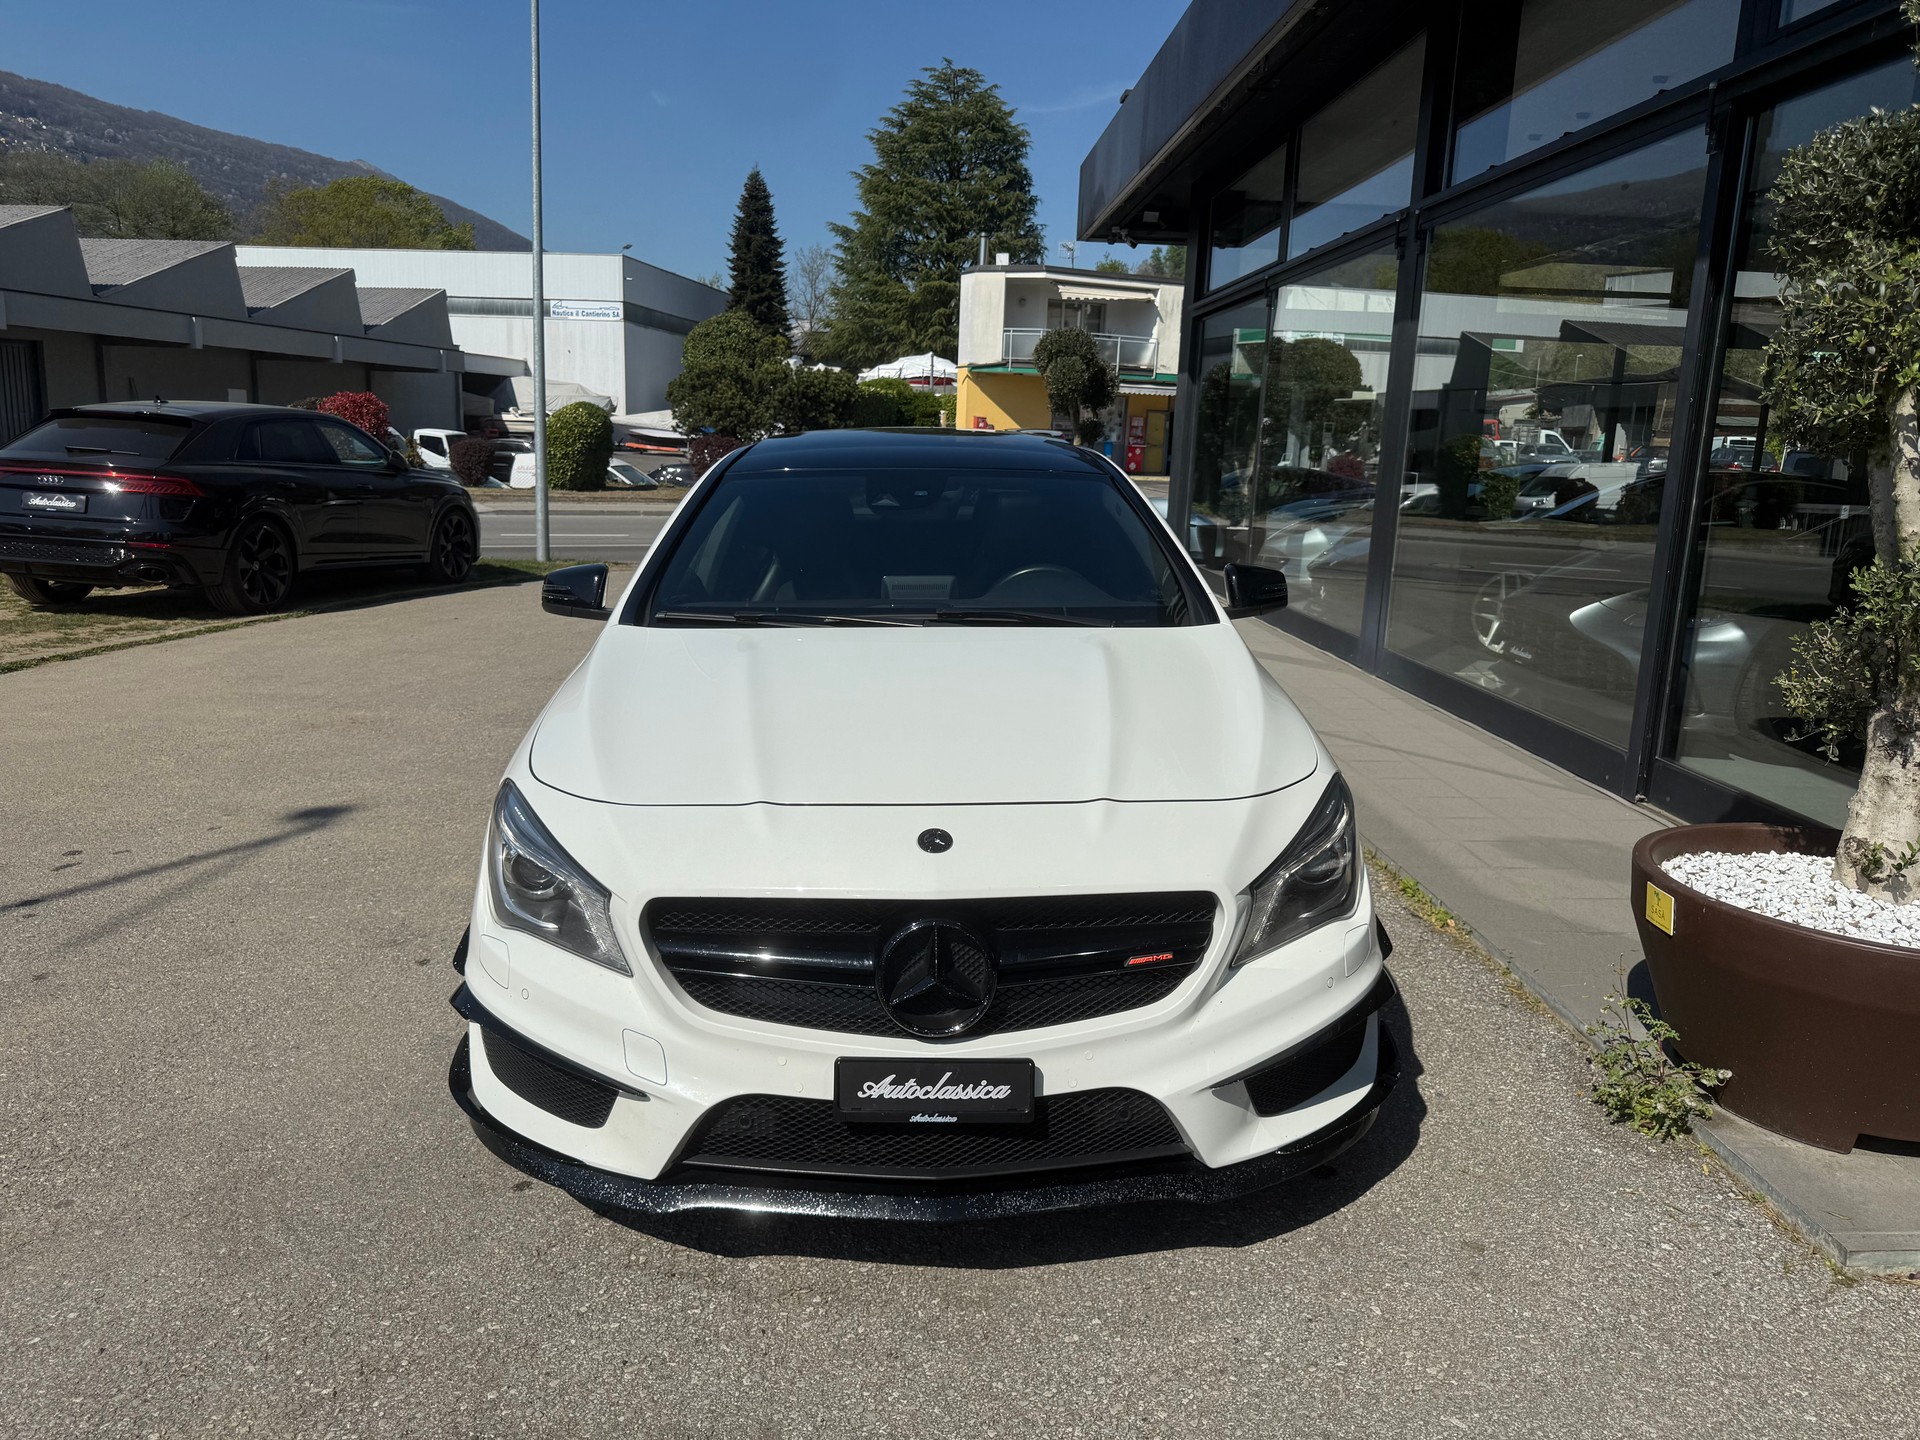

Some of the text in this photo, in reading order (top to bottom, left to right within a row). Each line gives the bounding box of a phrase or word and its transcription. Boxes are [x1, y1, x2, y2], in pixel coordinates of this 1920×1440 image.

[581, 310, 611, 318] Cantierino
[28, 495, 76, 507] Autoclassica
[857, 1071, 1011, 1100] Autoclassica
[909, 1112, 957, 1123] Autoclassica
